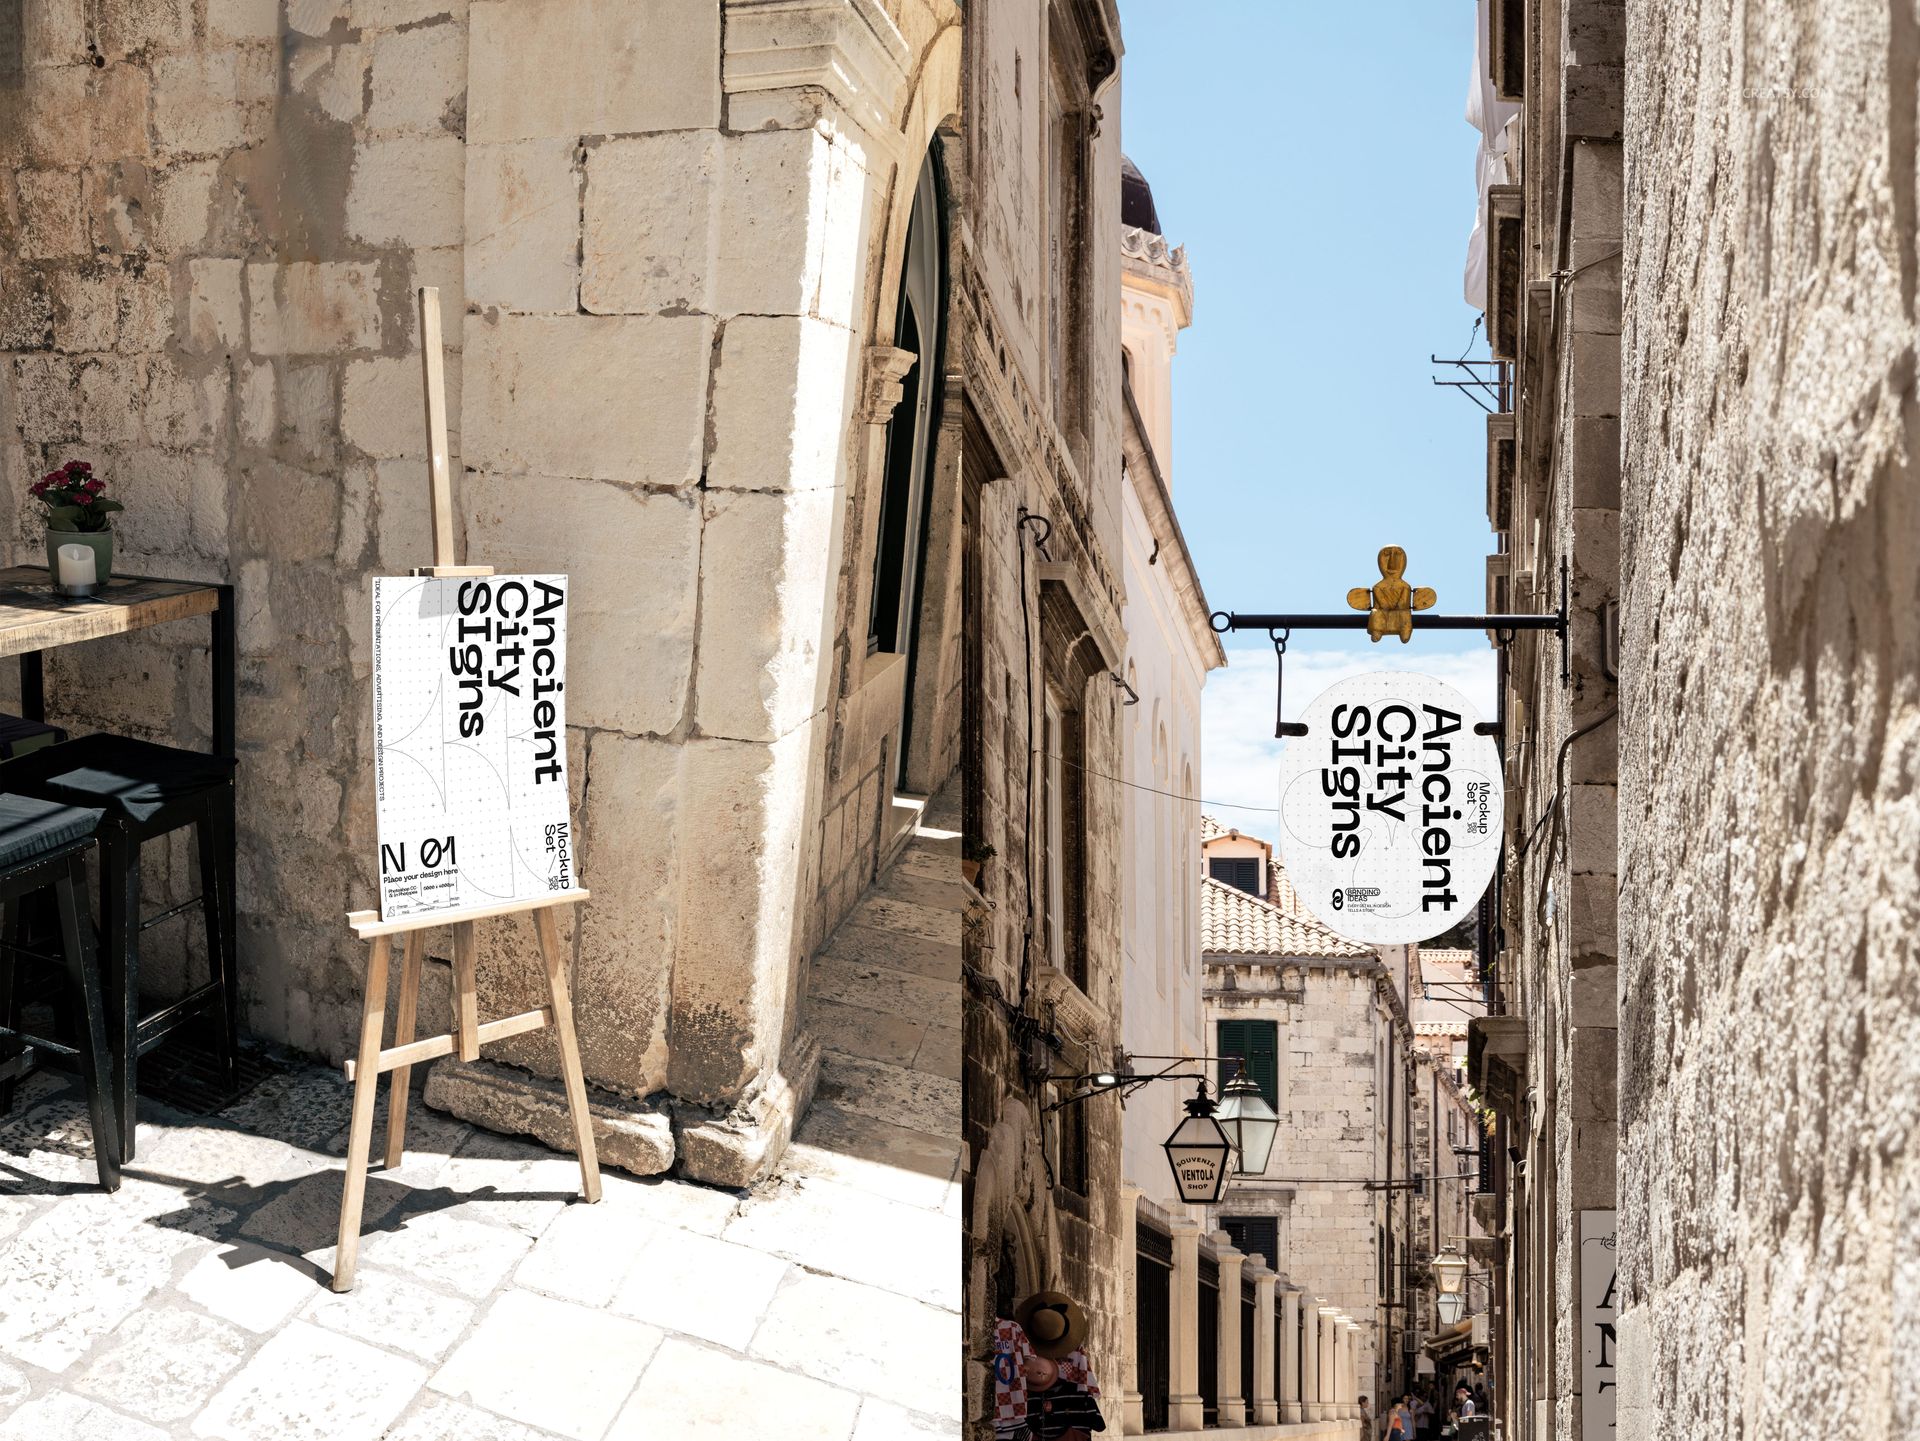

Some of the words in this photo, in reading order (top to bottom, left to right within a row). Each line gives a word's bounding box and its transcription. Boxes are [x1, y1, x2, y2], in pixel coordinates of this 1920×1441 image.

[488, 581, 528, 697] City
[532, 579, 564, 784] Ancient
[1366, 704, 1416, 822] City
[1422, 704, 1462, 912] Ancient
[1466, 782, 1478, 804] Set
[1478, 782, 1490, 834] Mockup
[545, 824, 556, 854] Set
[382, 842, 406, 874] N
[557, 822, 570, 890] Mockup
[404, 874, 418, 882] your
[420, 870, 443, 879] design
[1176, 1157, 1216, 1168] SOUVENIR
[1181, 1169, 1214, 1180] VENTOLA
[996, 1341, 1010, 1350] RIC
